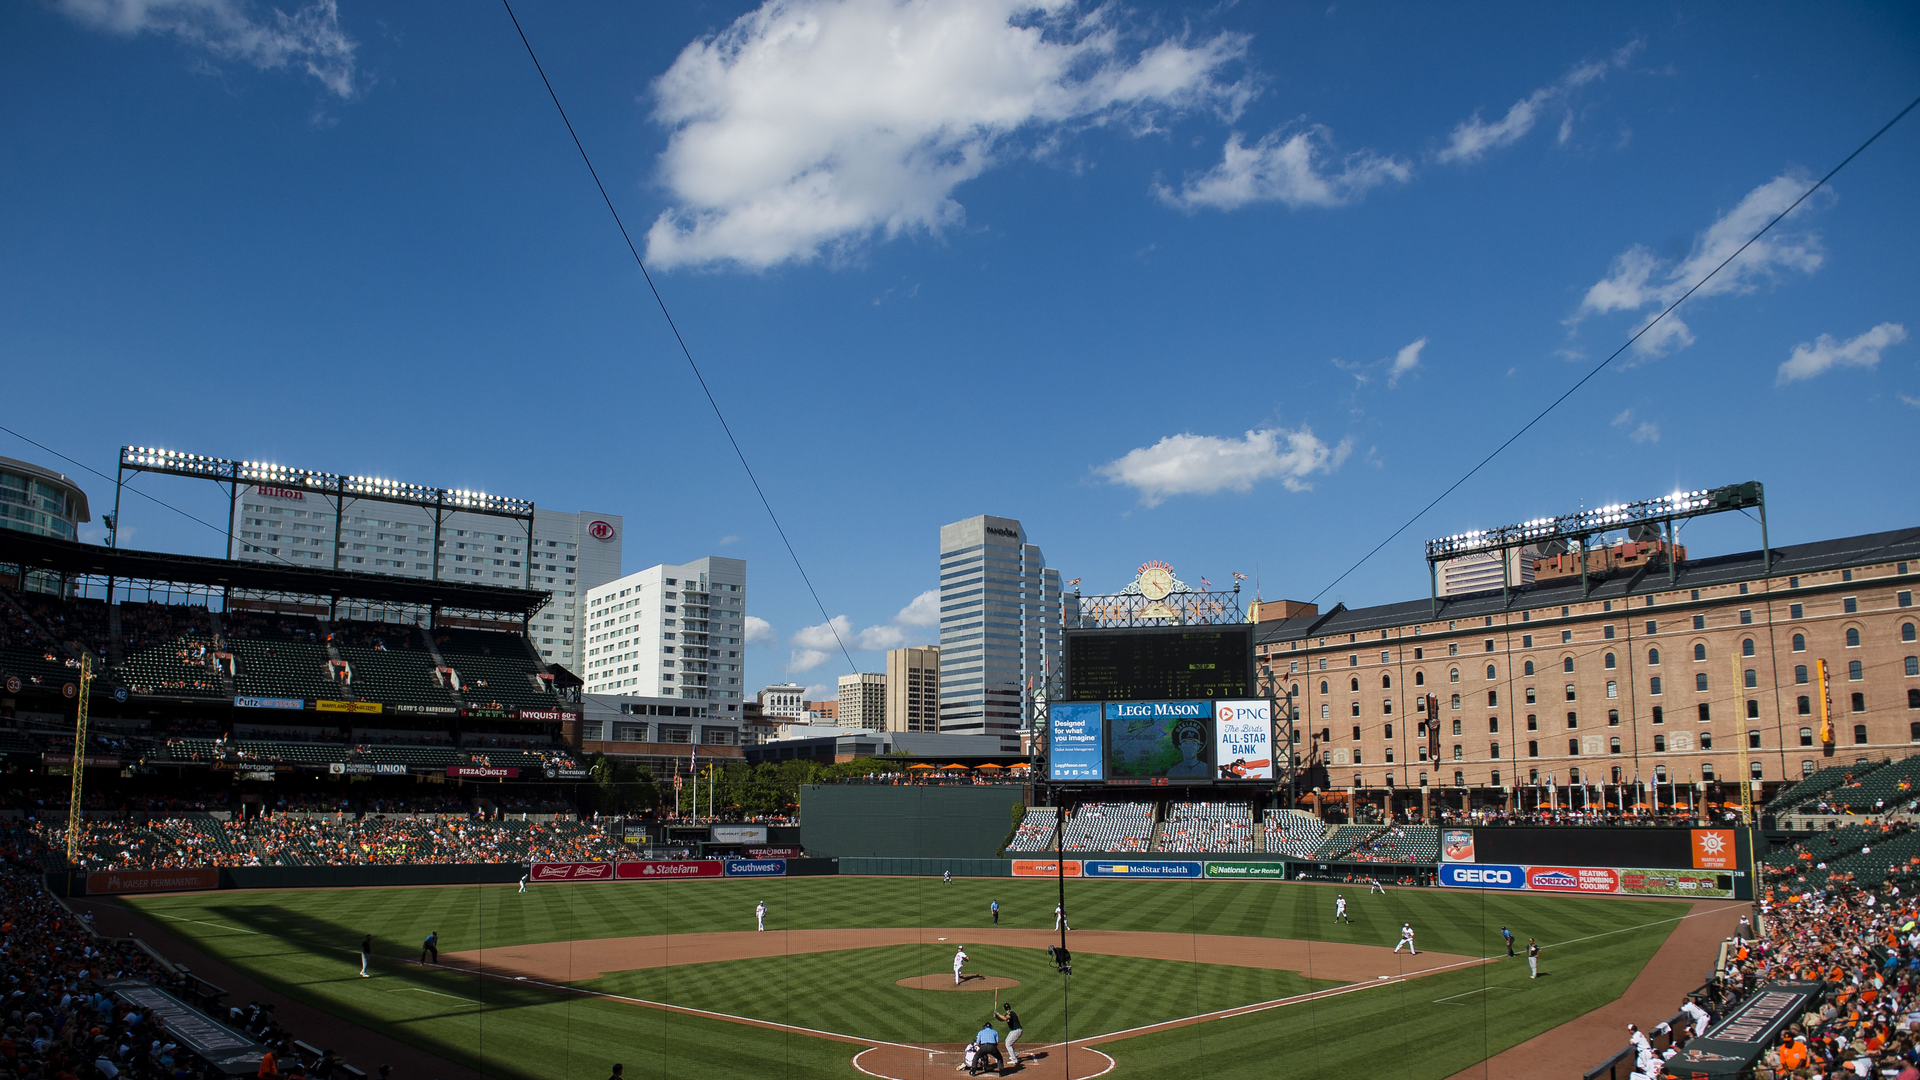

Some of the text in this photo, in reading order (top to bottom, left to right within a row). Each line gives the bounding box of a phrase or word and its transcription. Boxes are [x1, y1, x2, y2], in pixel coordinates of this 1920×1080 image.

[257, 486, 303, 499] Hilton
[1138, 560, 1174, 574] ORIOLES
[1091, 604, 1128, 620] THE
[1186, 601, 1222, 618] SUN
[10, 680, 20, 689] 33
[67, 686, 73, 694] 8
[116, 691, 126, 699] 42
[1118, 704, 1199, 716] LEGG MASON
[1236, 708, 1268, 719] PNC
[522, 711, 557, 719] NYQUIST
[1225, 724, 1263, 732] The Birds
[1222, 734, 1266, 743] ALL-STAR
[1232, 745, 1256, 754] BANK
[732, 863, 775, 872] Southwest
[1454, 869, 1511, 883] GEICO
[124, 878, 199, 888] KAISER PERMANENTE
